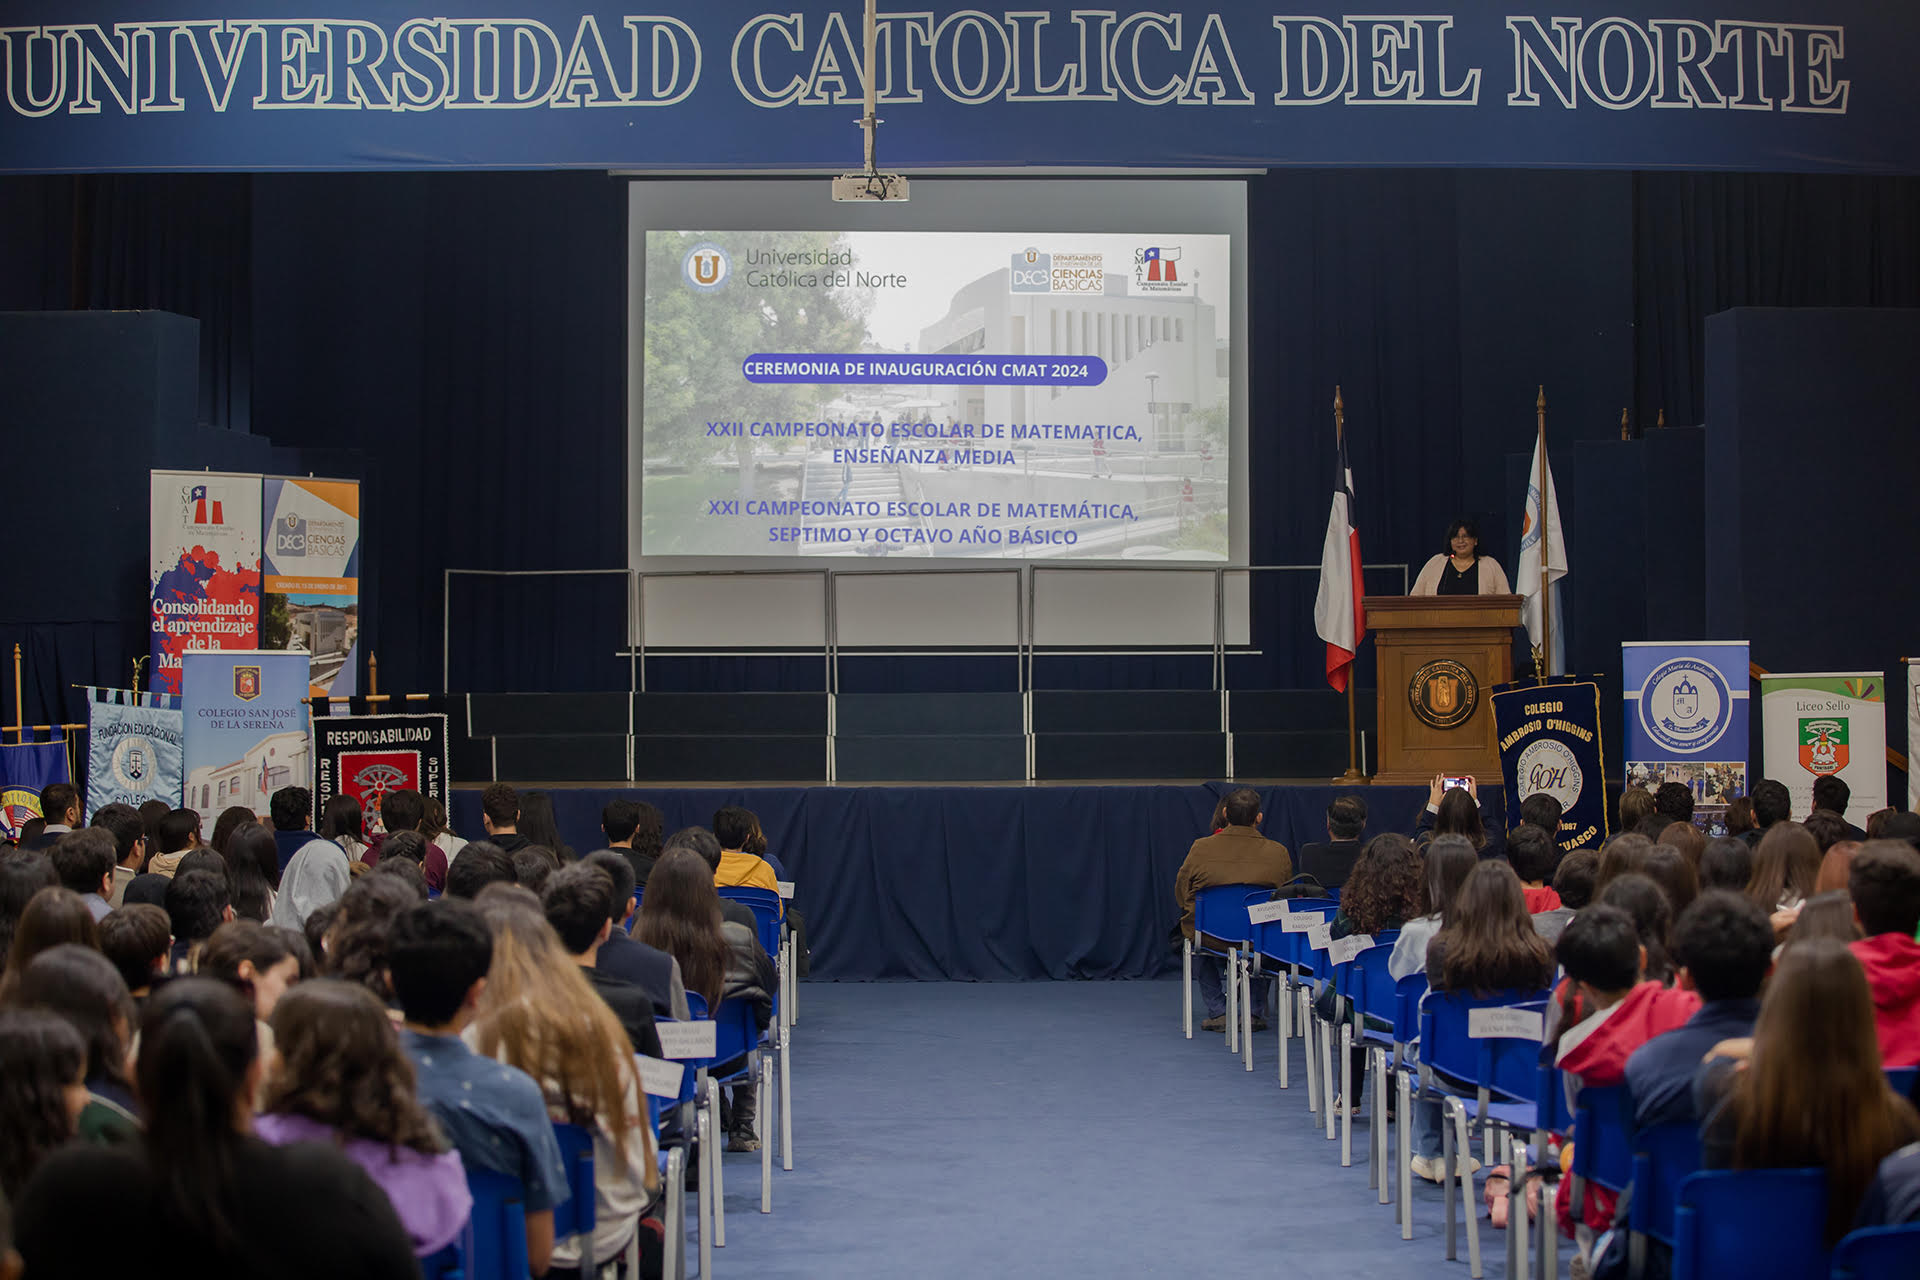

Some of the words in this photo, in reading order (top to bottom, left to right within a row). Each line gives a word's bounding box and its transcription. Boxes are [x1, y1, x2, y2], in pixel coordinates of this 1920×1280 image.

[1, 15, 702, 118] UNIVERSIDAD
[731, 10, 1256, 108] CATOLICA
[1273, 15, 1481, 106] DEL
[1506, 16, 1850, 115] NORTE
[746, 248, 852, 265] Universidad
[746, 270, 817, 288] Católica
[823, 271, 850, 288] del
[856, 272, 907, 288] Norte
[1052, 269, 1103, 279] CIENCIAS
[744, 361, 840, 376] CEREMONIA
[844, 362, 865, 376] DE
[869, 359, 997, 377] INAUGURACIÓN
[1001, 363, 1047, 378] CMAT
[1051, 364, 1089, 378] 2024
[706, 422, 743, 436] XXII
[750, 422, 885, 437] CAMPEONATO
[891, 423, 975, 438] ESCOLAR
[981, 424, 1004, 439] DE
[1011, 425, 1143, 442] MATEMATICA,
[833, 445, 948, 464] ENSEÑANZA
[954, 450, 1016, 465] MEDIA
[708, 500, 739, 515] XXI
[745, 501, 881, 516] CAMPEONATO
[887, 502, 971, 517] ESCOLAR
[977, 503, 1001, 517] DE
[1007, 500, 1139, 521] MATEMÁTICA,
[307, 534, 346, 545] CIENCIAS
[768, 527, 852, 542] SEPTIMO
[857, 528, 869, 542] Y
[875, 528, 953, 544] OCTAVO
[959, 525, 1002, 544] AÑO
[1008, 526, 1078, 545] BÁSICO
[153, 598, 254, 616] Consolidando
[152, 616, 165, 632] el
[167, 617, 254, 637] aprendizaje
[187, 634, 205, 650] de
[207, 635, 221, 650] la
[198, 708, 246, 718] COLEGIO
[248, 708, 269, 718] SAN
[1524, 701, 1563, 716] COLEGIO
[1796, 701, 1823, 712] Liceo
[1825, 700, 1850, 711] Sello
[98, 723, 133, 740] FUNDACION
[134, 723, 176, 745] EDUCACIONAL
[211, 720, 225, 729] DE
[227, 720, 240, 729] LA
[327, 727, 432, 746] RESPONSABILIDAD
[1500, 719, 1542, 752] AMBROSIO
[1546, 719, 1593, 742] O'HIGGINS
[1525, 742, 1563, 759] AMBROSIO
[1563, 749, 1580, 794] O'HIGGINS
[428, 757, 439, 799] SUPER
[1558, 825, 1598, 851] UASCO
